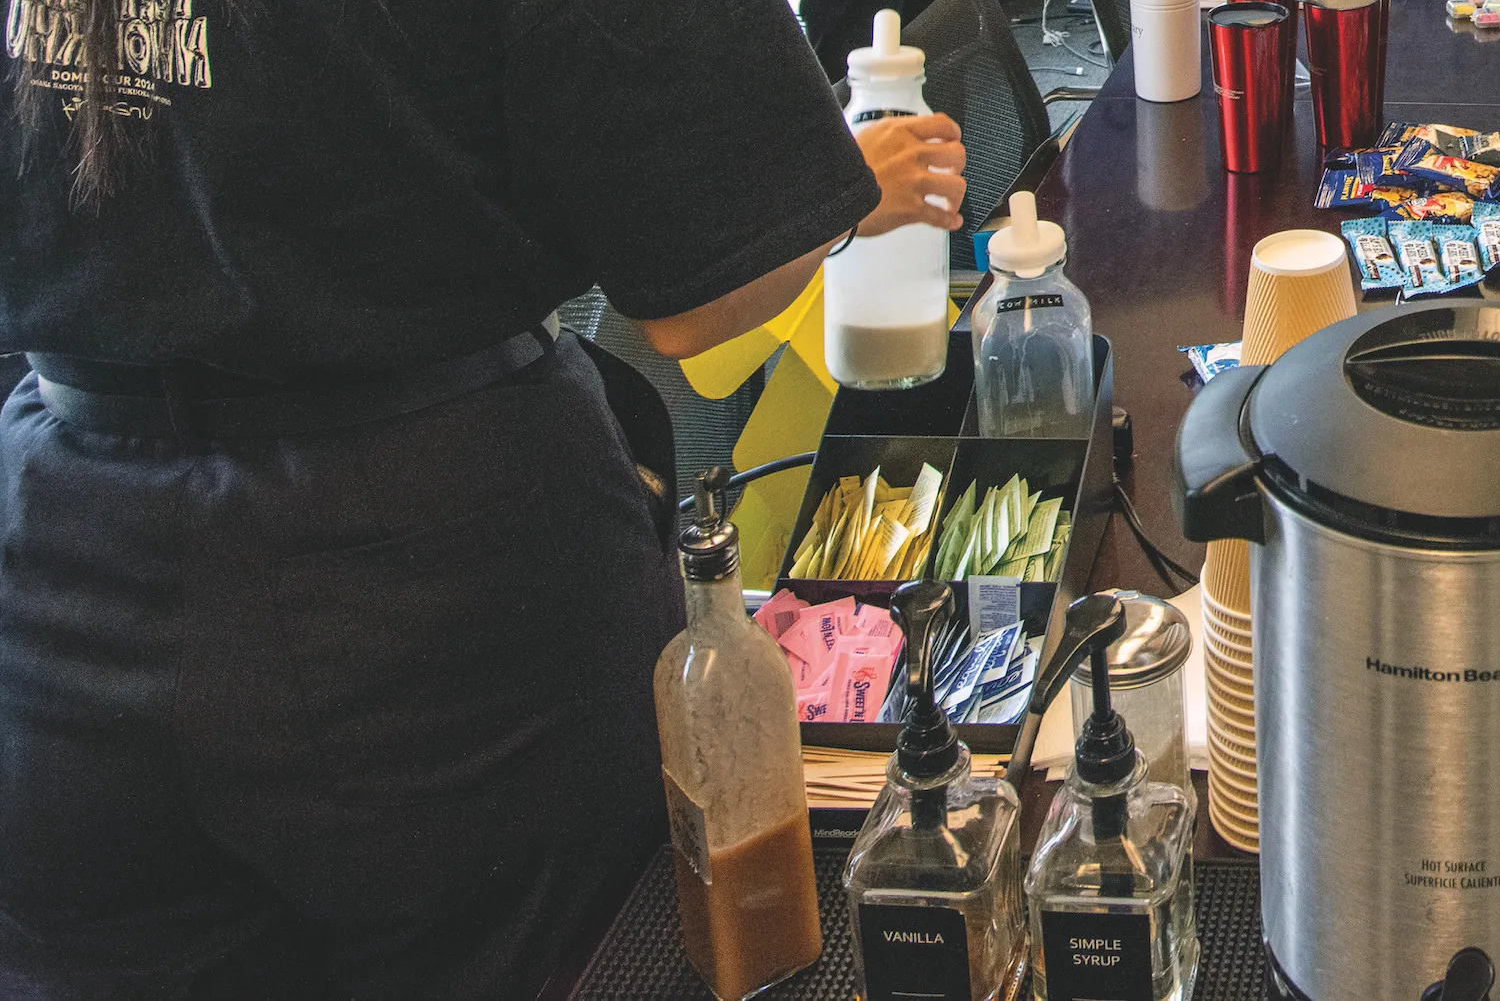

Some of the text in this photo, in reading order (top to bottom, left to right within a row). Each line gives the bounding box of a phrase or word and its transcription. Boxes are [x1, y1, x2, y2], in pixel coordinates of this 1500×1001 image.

[1366, 657, 1460, 683] Hamilton
[1422, 859, 1486, 873] HOT SURFACE
[1405, 873, 1456, 888] SUPERFICIE
[884, 931, 944, 944] VANILLA
[1070, 938, 1121, 951] SIMPLE
[1073, 954, 1120, 967] SYRUP
